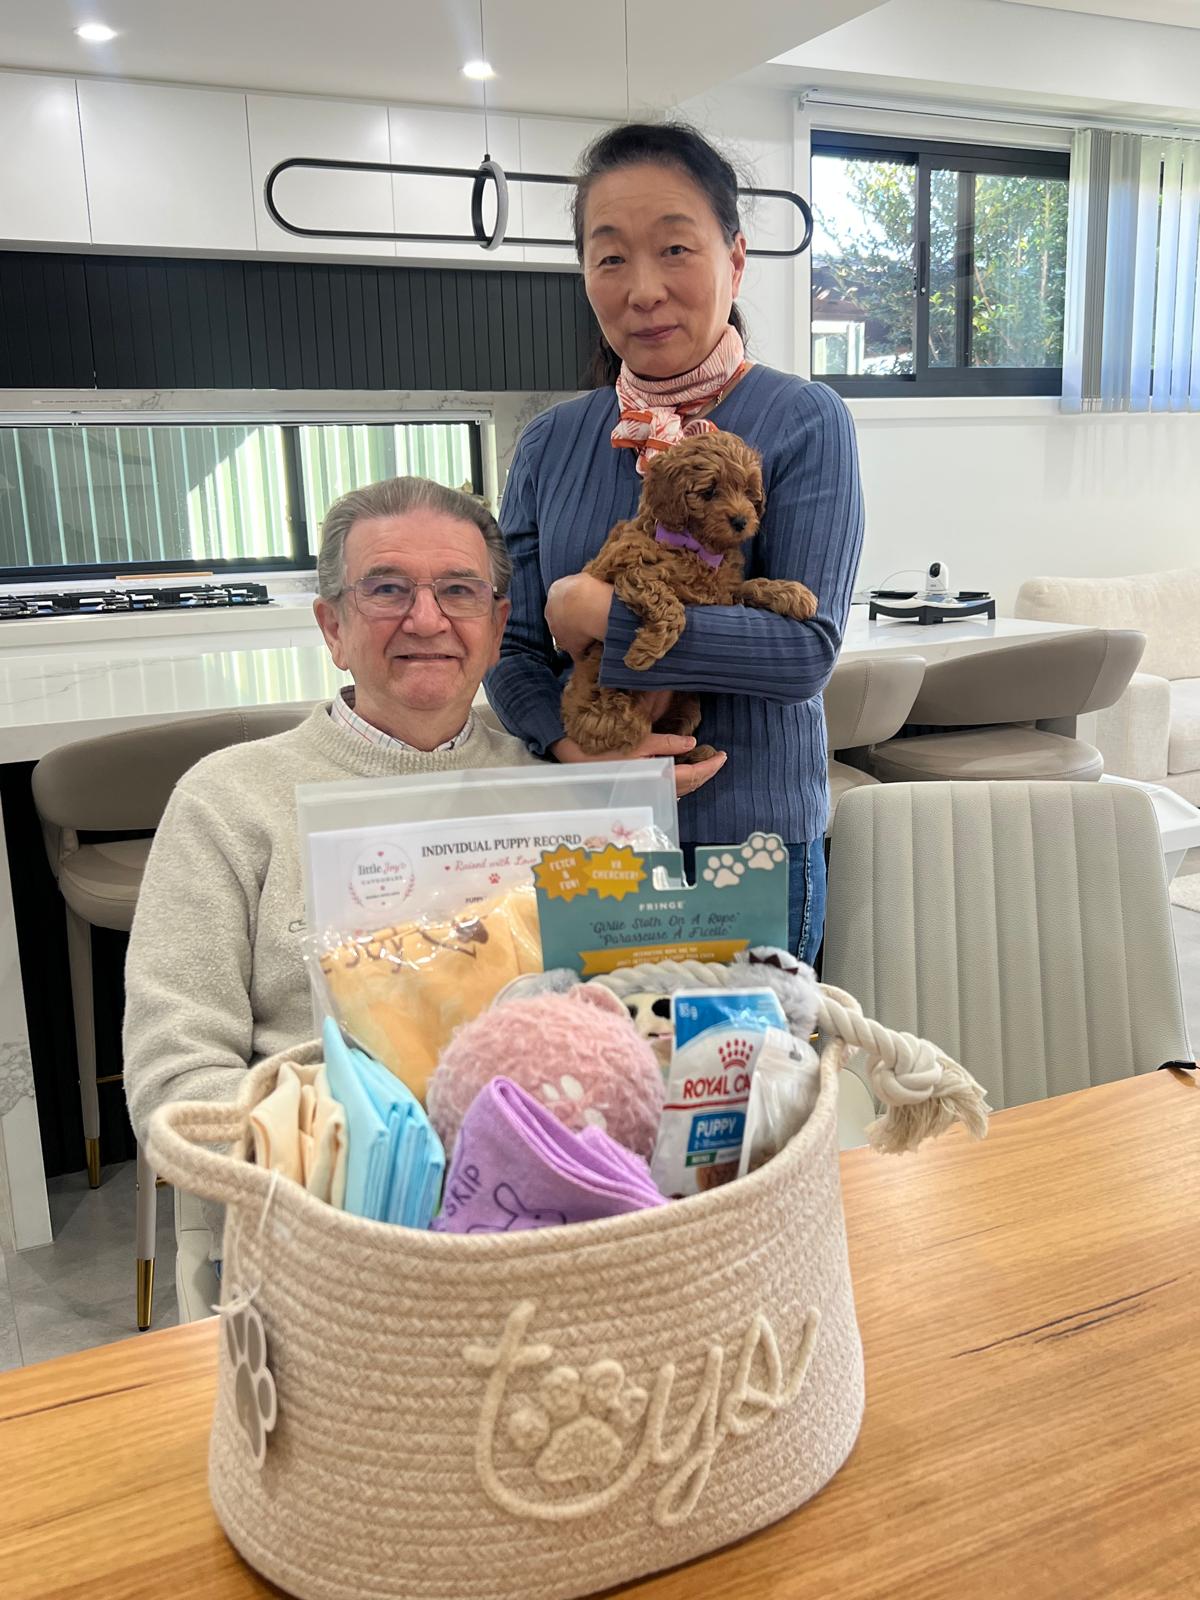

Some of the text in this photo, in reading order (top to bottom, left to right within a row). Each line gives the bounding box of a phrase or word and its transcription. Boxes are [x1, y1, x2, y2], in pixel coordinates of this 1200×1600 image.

[421, 834, 582, 857] INDIVIDUAL PUPPY RECORD
[358, 862, 382, 876] little
[455, 857, 487, 871] Raised
[489, 857, 510, 868] with
[549, 857, 577, 871] FETCH
[561, 870, 570, 880] &
[592, 870, 639, 880] CHERCHER!
[560, 878, 580, 891] FUN!
[639, 901, 685, 912] FRINGE
[632, 916, 662, 930] Sloth
[668, 915, 685, 926] On
[691, 913, 701, 925] A
[683, 1073, 751, 1099] ROYAL CA
[696, 1116, 737, 1138] PUPPY
[445, 1164, 482, 1217] SKIP
